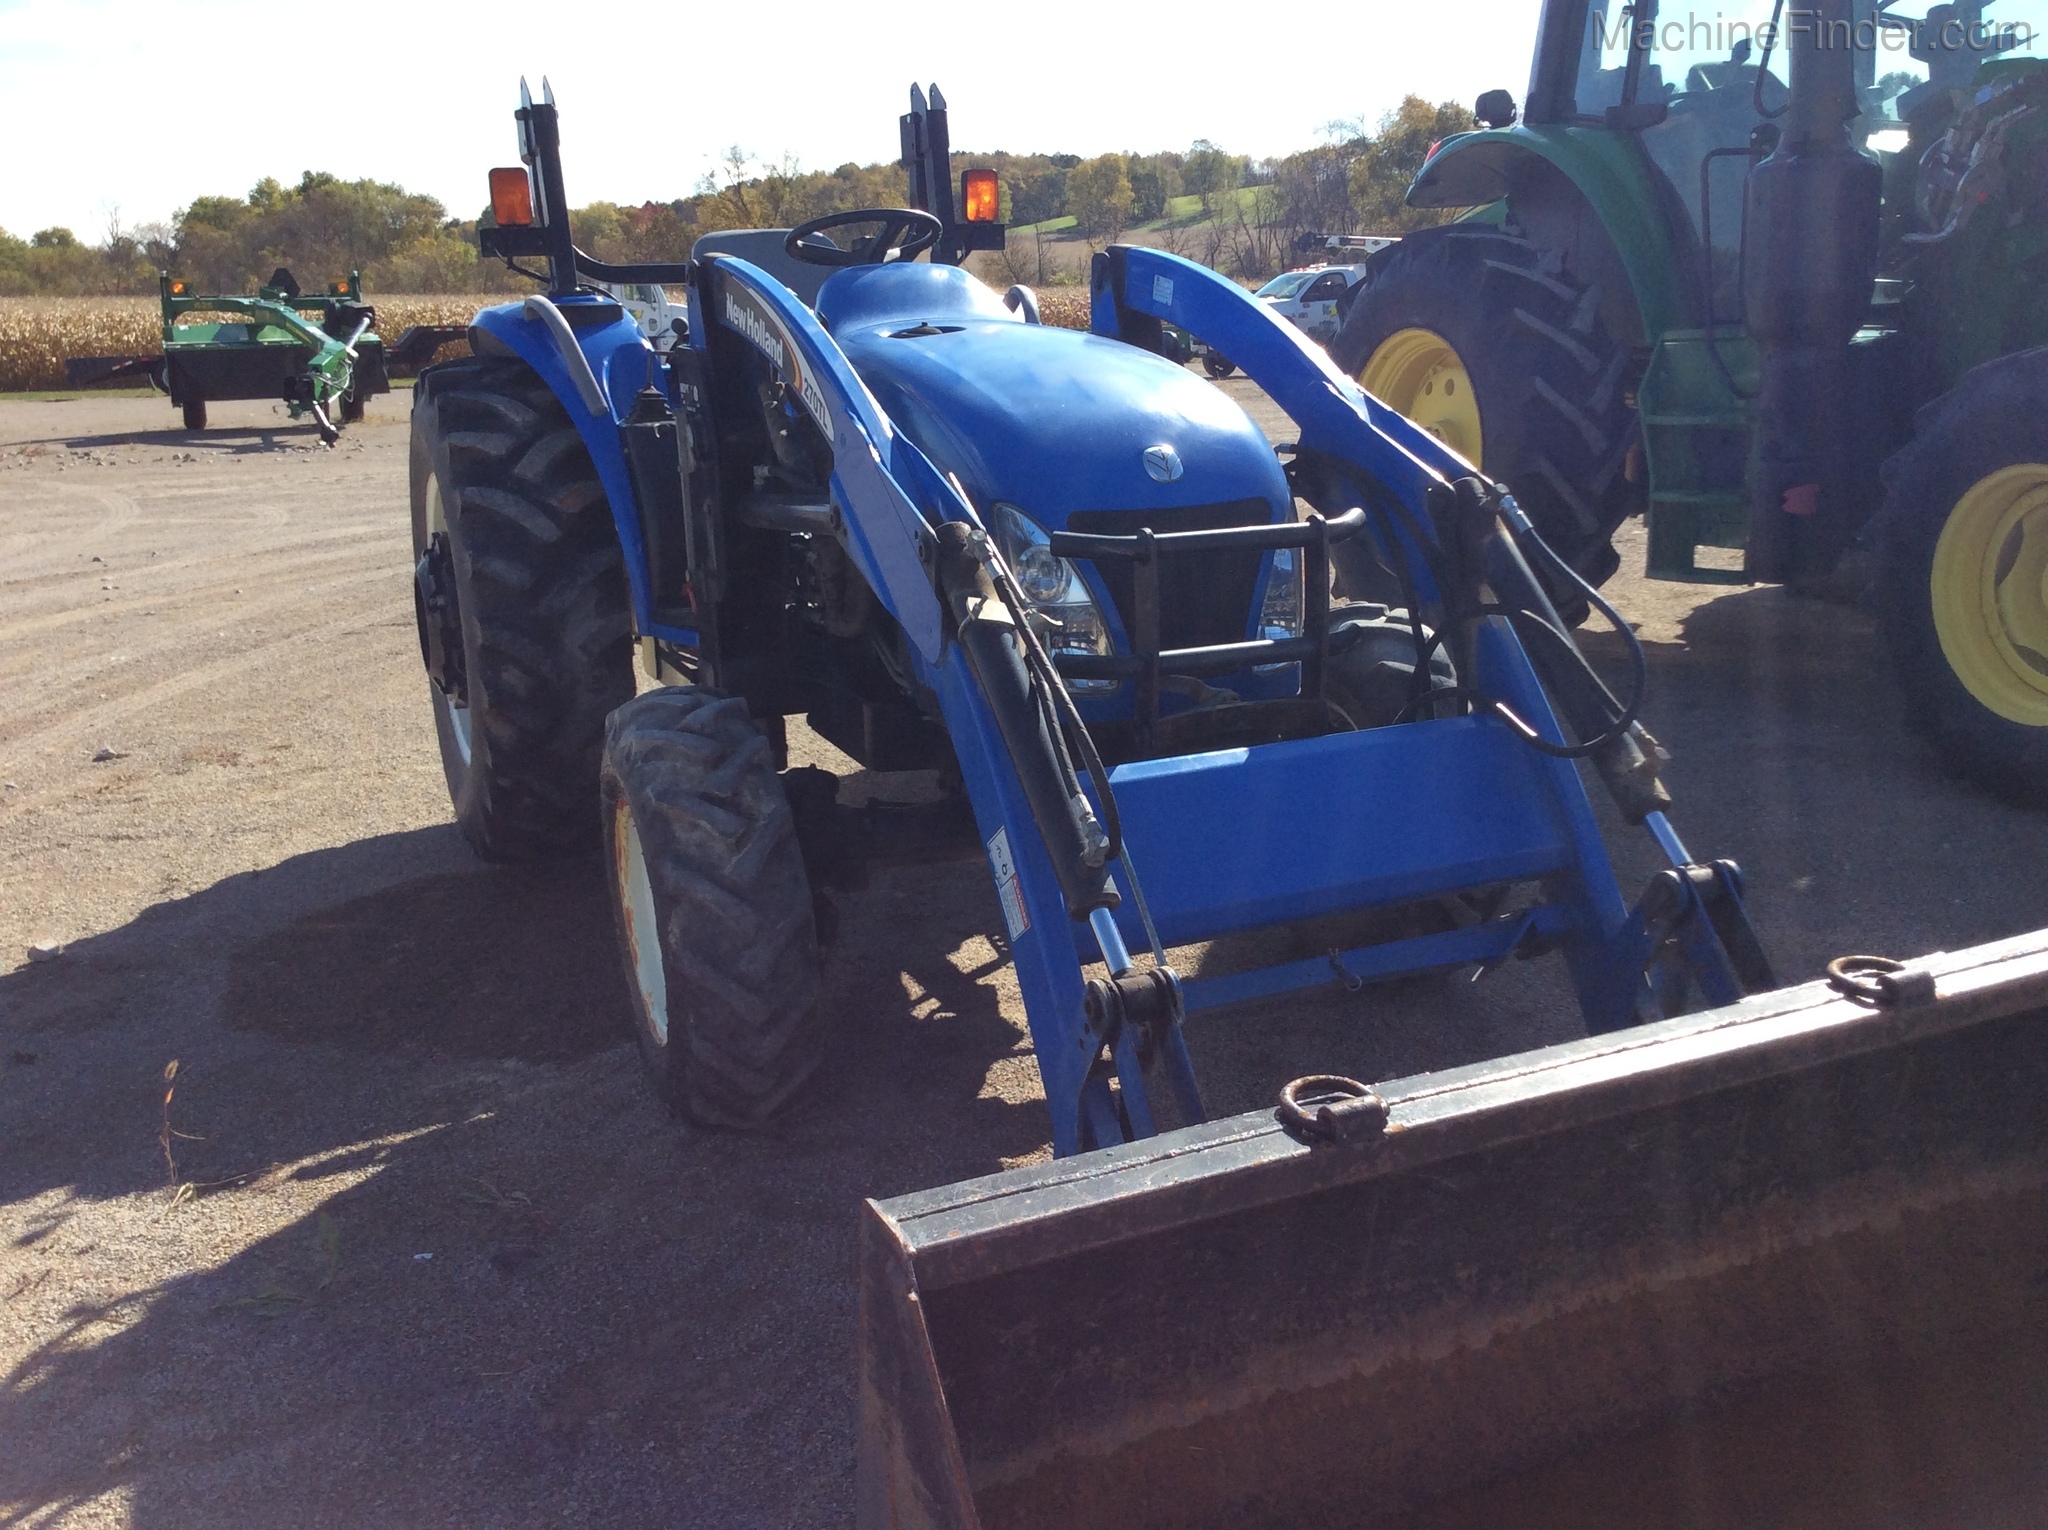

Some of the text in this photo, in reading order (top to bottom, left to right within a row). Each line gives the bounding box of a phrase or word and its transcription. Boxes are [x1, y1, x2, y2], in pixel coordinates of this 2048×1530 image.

[726, 292, 783, 368] New Holland
[804, 377, 827, 430] 270TL
